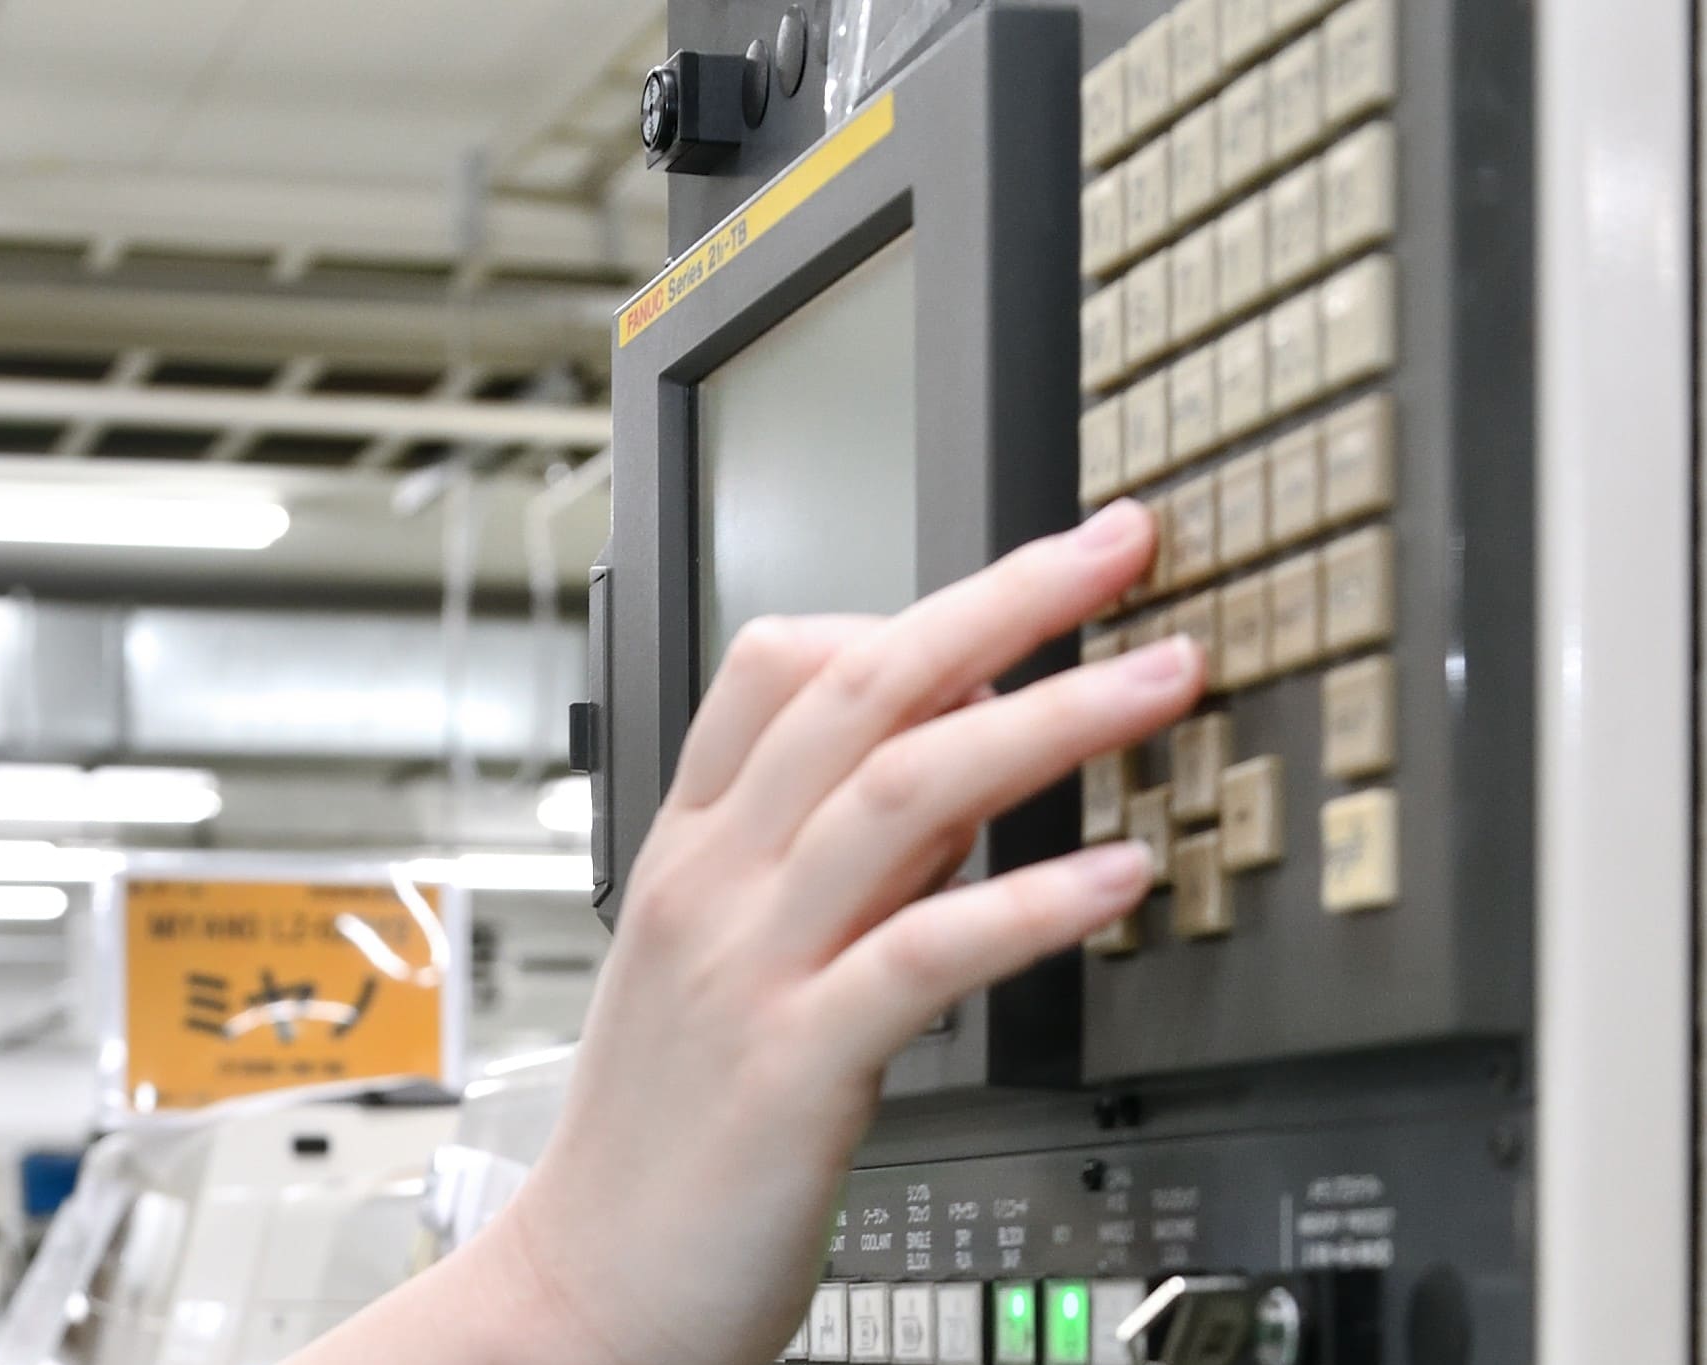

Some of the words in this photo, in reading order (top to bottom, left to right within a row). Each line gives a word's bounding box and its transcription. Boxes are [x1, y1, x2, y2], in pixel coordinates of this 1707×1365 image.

[627, 287, 663, 337] FANUC
[668, 259, 703, 302] Series
[184, 966, 379, 1044] ミヤノ
[860, 1232, 894, 1251] COOLANT
[906, 1231, 932, 1249] SINGLE
[906, 1252, 931, 1271] BLOCK
